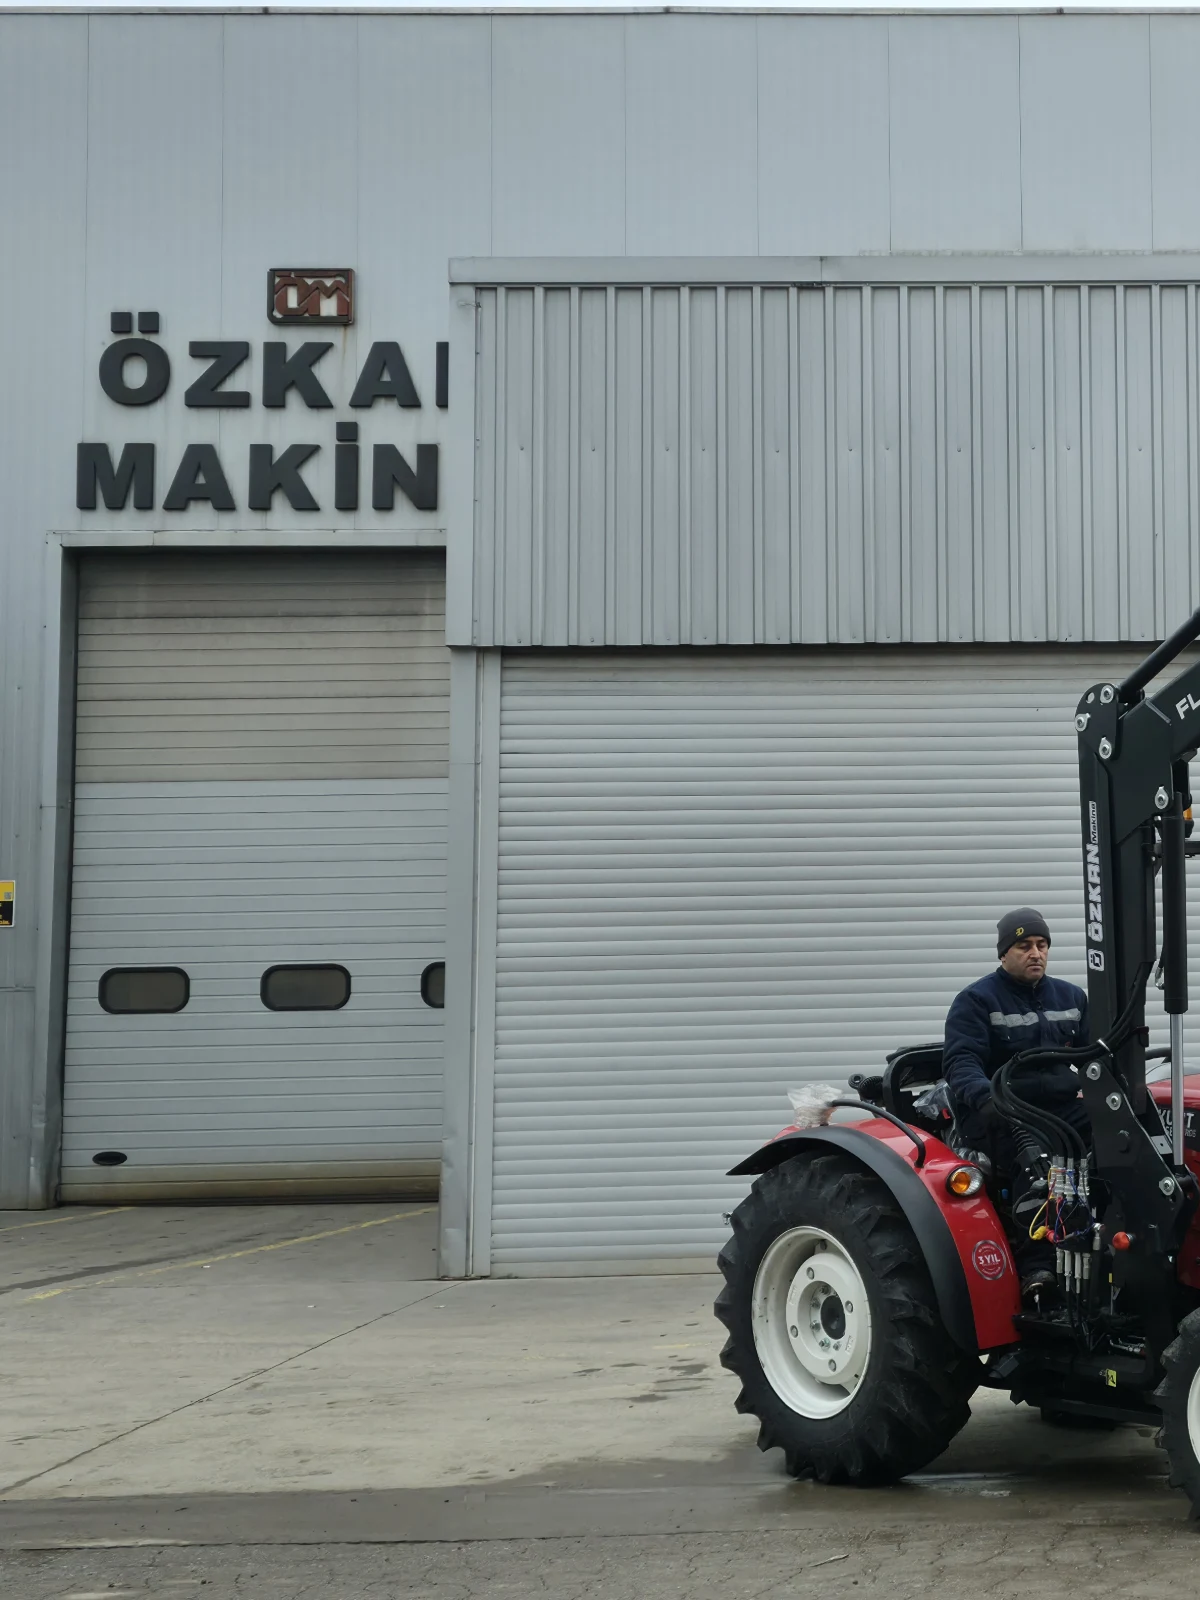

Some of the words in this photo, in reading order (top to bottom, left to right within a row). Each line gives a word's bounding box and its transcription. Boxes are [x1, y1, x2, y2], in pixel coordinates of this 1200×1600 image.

[98, 311, 449, 408] ÖZKA
[76, 421, 439, 511] MAKİN
[1090, 802, 1098, 843] Makina
[1086, 842, 1104, 943] ÖZKAN
[977, 1255, 985, 1265] 3
[984, 1253, 1001, 1264] YIL
